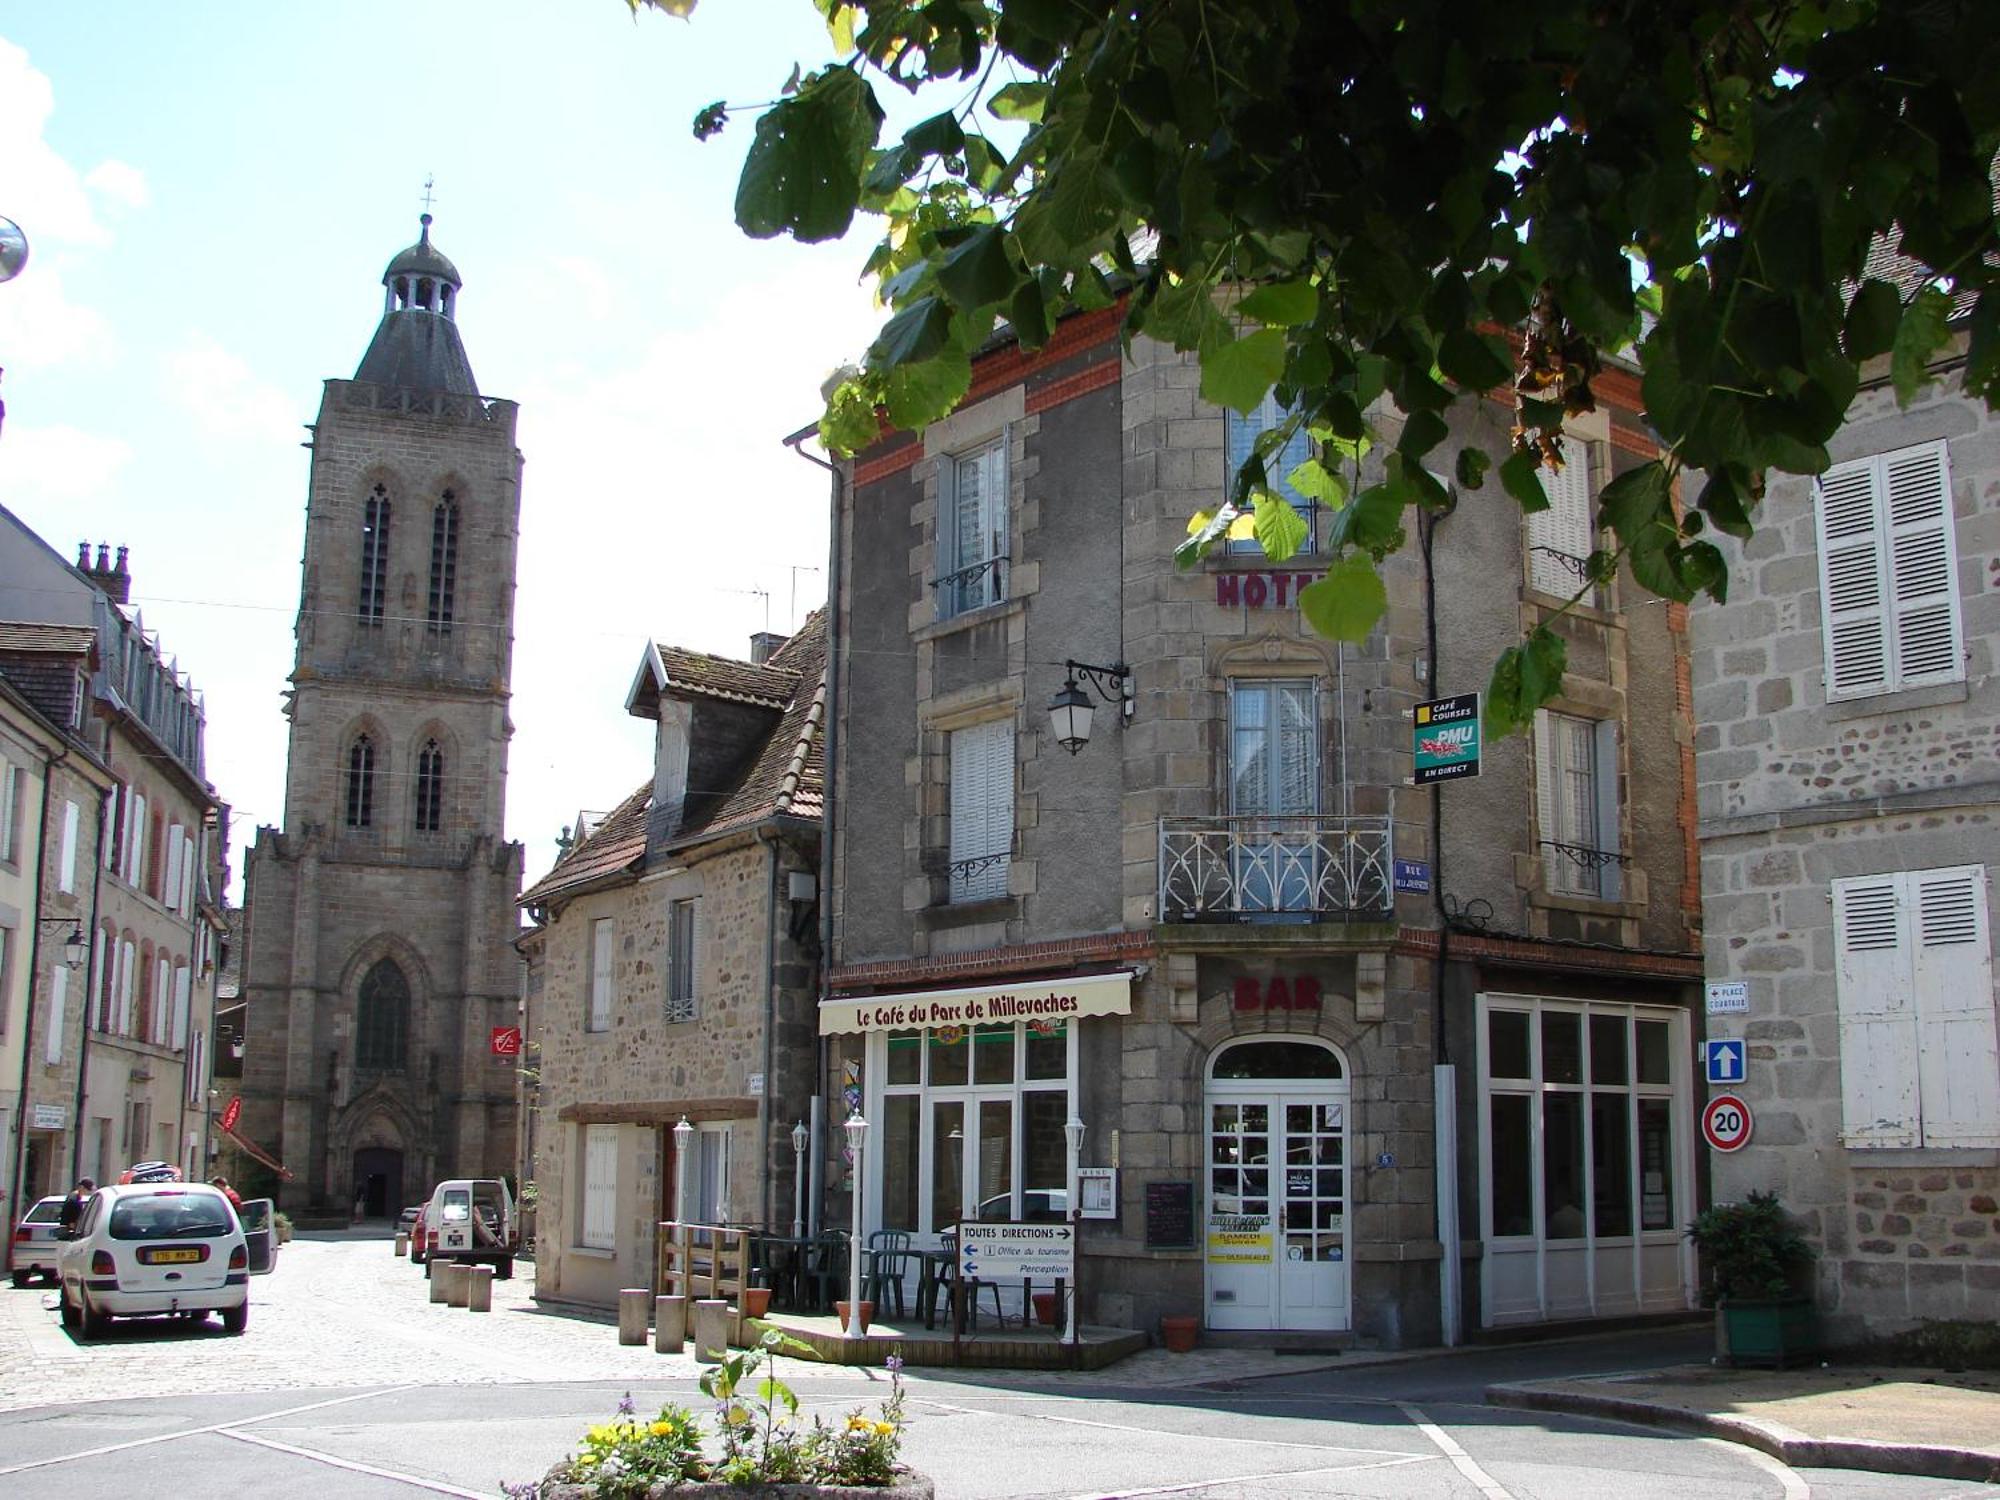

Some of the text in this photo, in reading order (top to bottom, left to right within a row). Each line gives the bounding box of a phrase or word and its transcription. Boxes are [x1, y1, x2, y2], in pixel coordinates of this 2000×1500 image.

[1433, 700, 1456, 712] CAFÉ
[1432, 708, 1472, 721] COURSES
[1438, 726, 1473, 745] PMU
[1425, 764, 1468, 777] EN DIRECT
[1233, 973, 1322, 1010] BAR
[1722, 987, 1744, 996] PLACE
[856, 993, 1078, 1026] Le Café du Parc de Millevaches
[1714, 1112, 1740, 1132] 20
[964, 1228, 1054, 1238] TOUTES DIRECTIONS
[997, 1246, 1020, 1255] Office
[1023, 1247, 1034, 1255] du
[1038, 1247, 1070, 1255] tourisme
[1020, 1264, 1068, 1275] Perception
